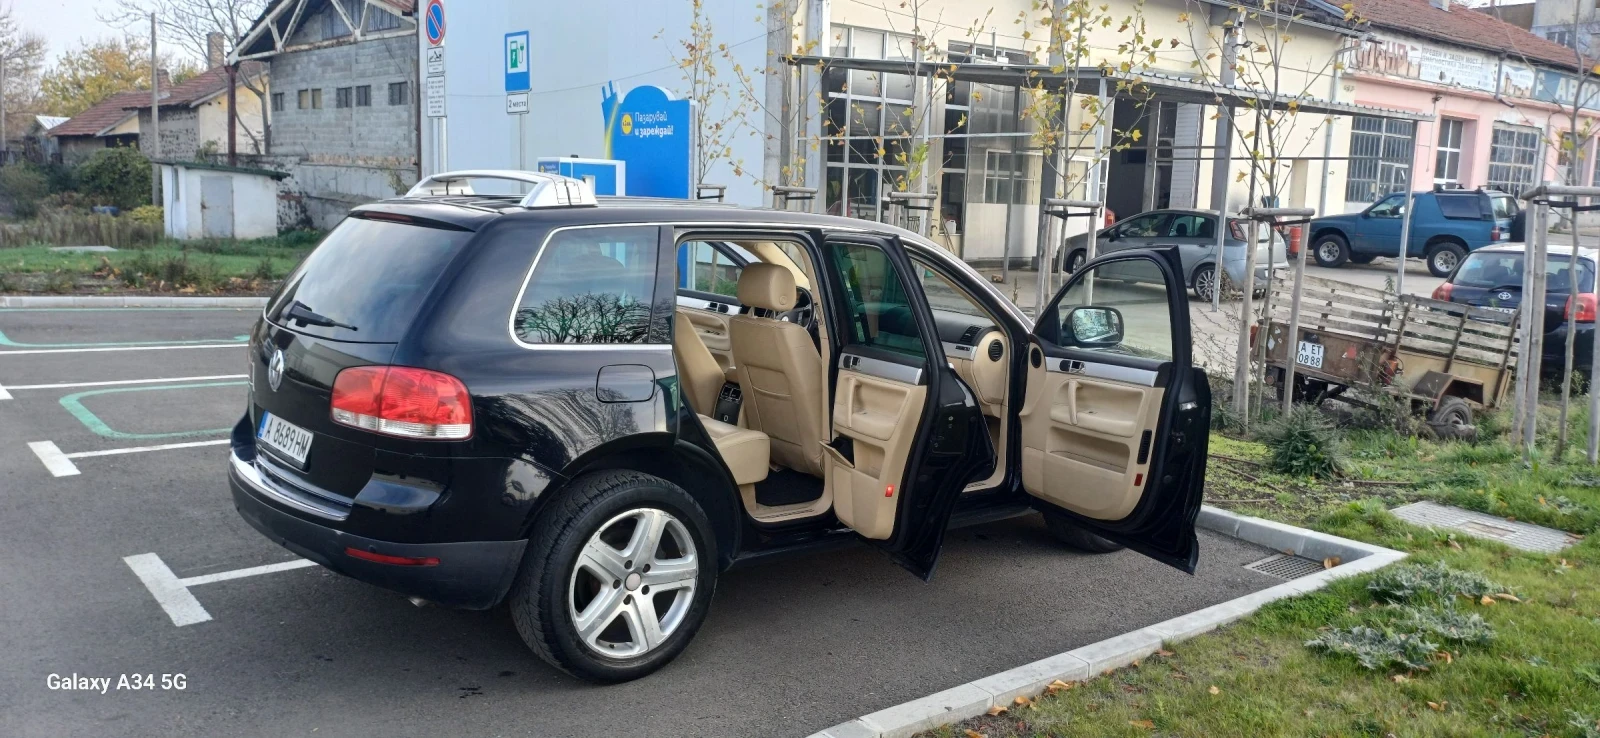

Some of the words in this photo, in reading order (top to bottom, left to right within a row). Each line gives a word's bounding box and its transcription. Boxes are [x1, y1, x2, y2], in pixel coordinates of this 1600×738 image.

[508, 100, 512, 108] 2
[635, 111, 668, 124] Пазарувай
[640, 125, 674, 138] зареждай!
[1300, 342, 1307, 352] A
[1311, 344, 1322, 356] ET
[1299, 353, 1321, 366] 0888
[265, 418, 274, 439] A
